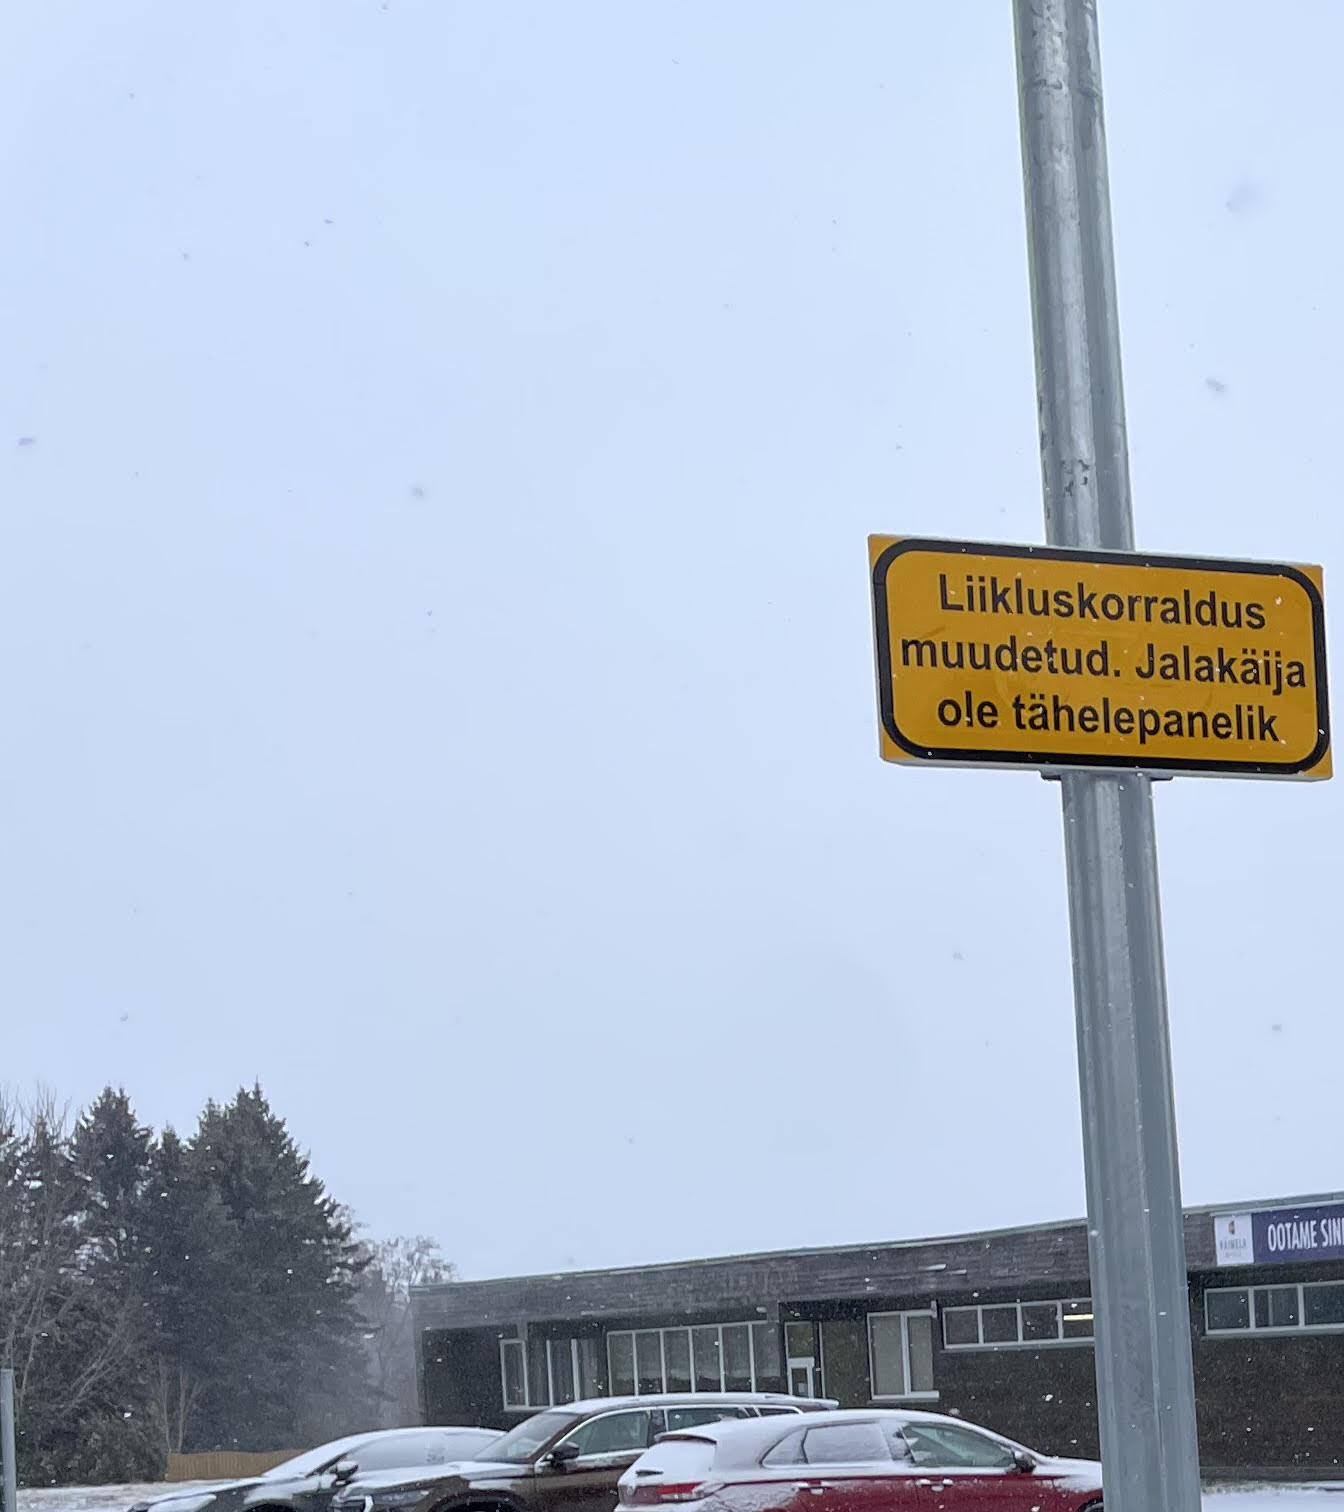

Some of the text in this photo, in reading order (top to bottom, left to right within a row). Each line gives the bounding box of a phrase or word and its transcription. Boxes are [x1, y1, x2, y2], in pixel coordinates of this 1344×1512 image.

[939, 574, 1265, 628] Liikluskorraldus
[901, 637, 1306, 695] muudetud. Jalakäija
[937, 691, 1280, 744] ole tähelepanelik
[1268, 1221, 1317, 1251] OOTAME
